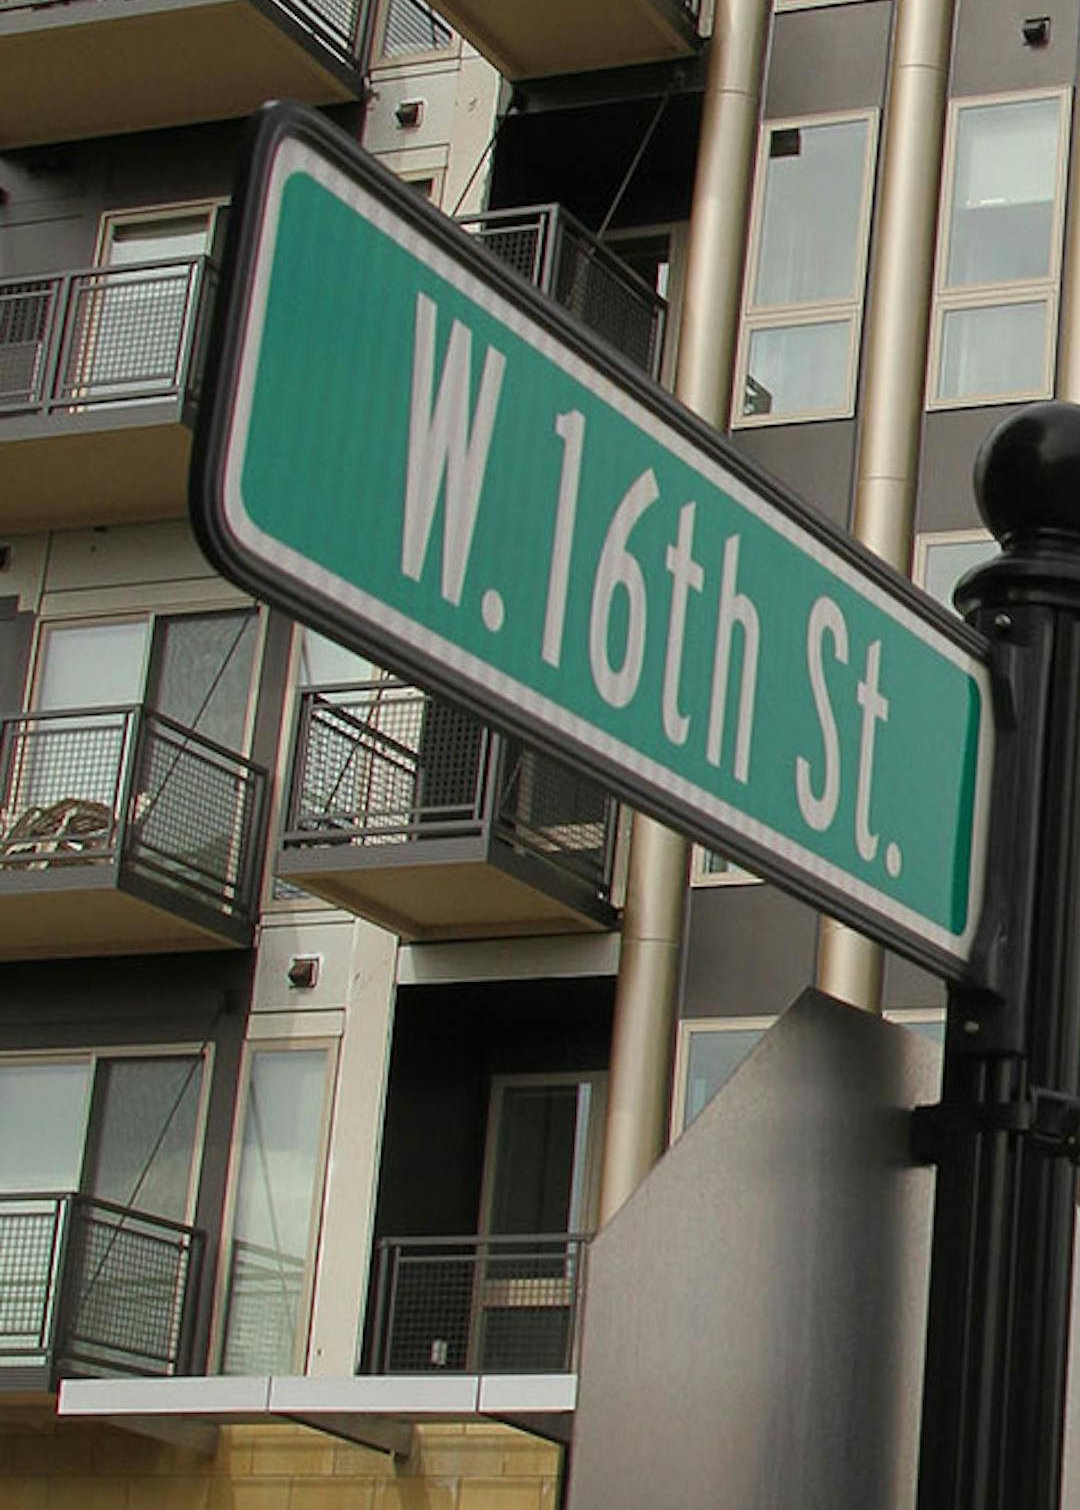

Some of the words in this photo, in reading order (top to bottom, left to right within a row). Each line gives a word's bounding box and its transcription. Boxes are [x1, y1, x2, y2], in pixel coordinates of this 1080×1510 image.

[401, 292, 506, 633] W.
[541, 408, 760, 784] 16th
[796, 594, 902, 879] St.
